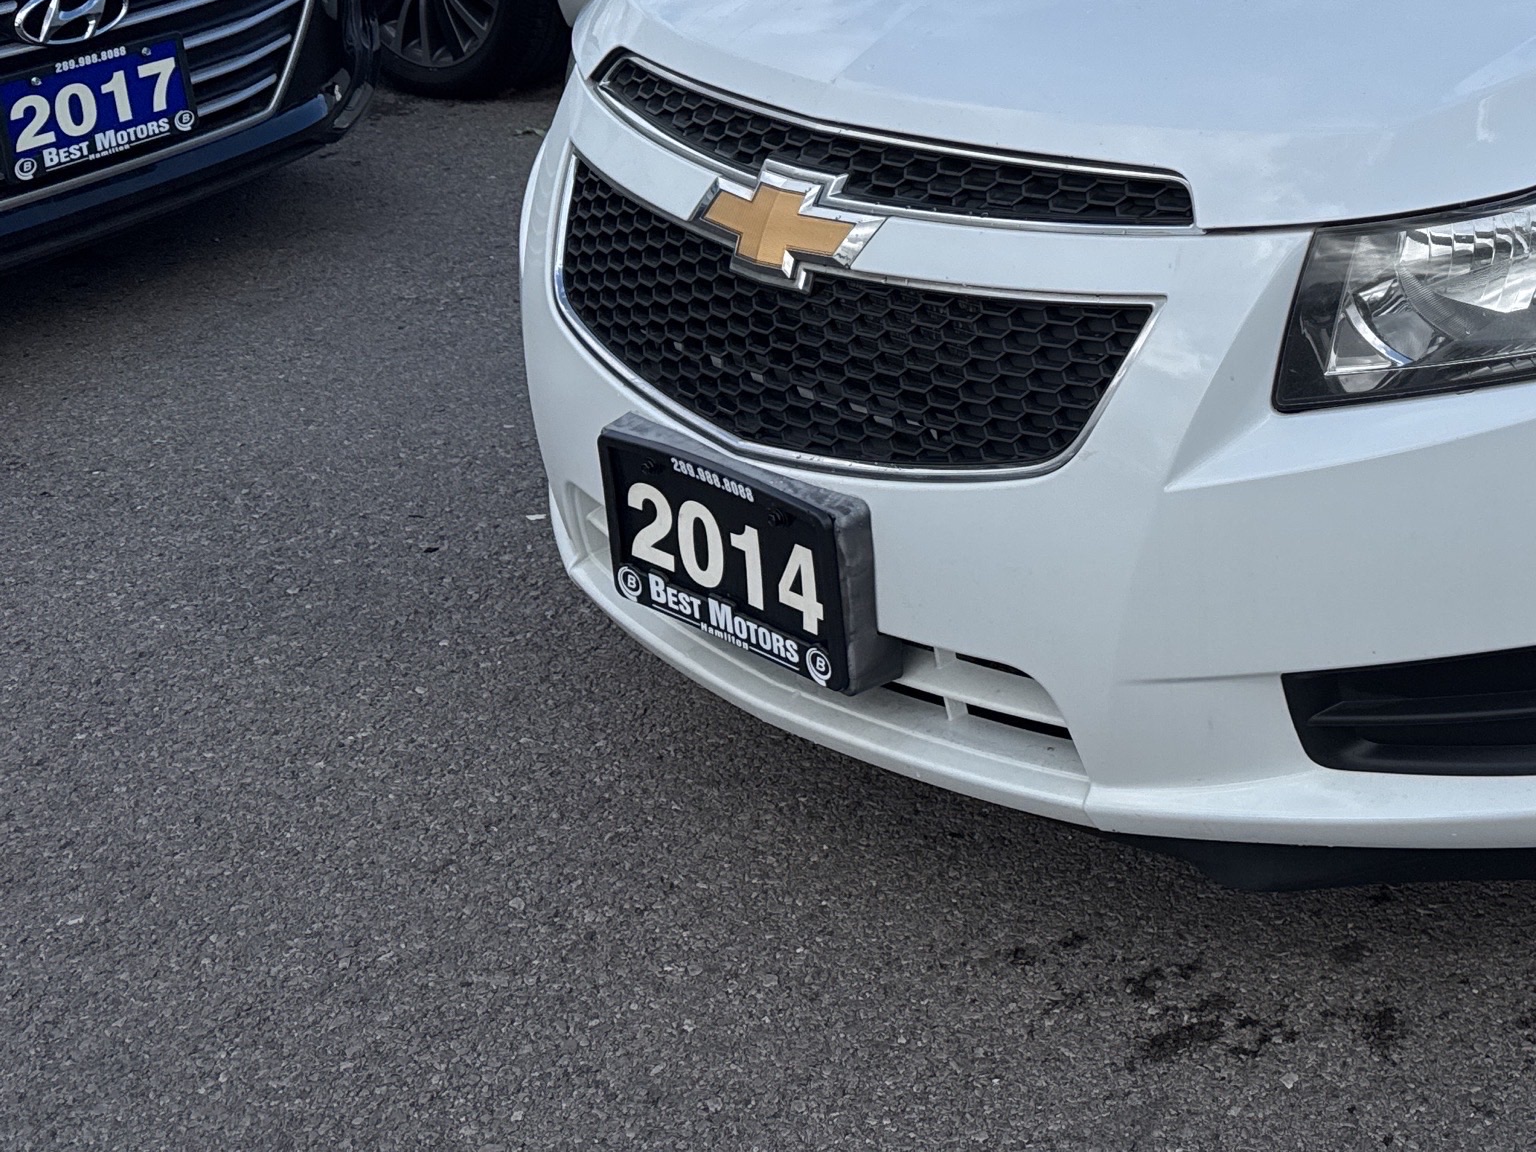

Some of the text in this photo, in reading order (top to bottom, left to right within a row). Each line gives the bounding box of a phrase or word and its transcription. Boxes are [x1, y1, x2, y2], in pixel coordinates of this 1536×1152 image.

[55, 46, 127, 74] 289.988.8088
[10, 56, 176, 153] 2017
[43, 117, 170, 168] BEST MOTORS
[88, 143, 131, 161] Hamilton
[670, 456, 755, 503] 289.988.8088
[627, 482, 824, 636] 2014
[648, 573, 800, 664] BEST MOTORS
[700, 622, 750, 651] Hamilton
